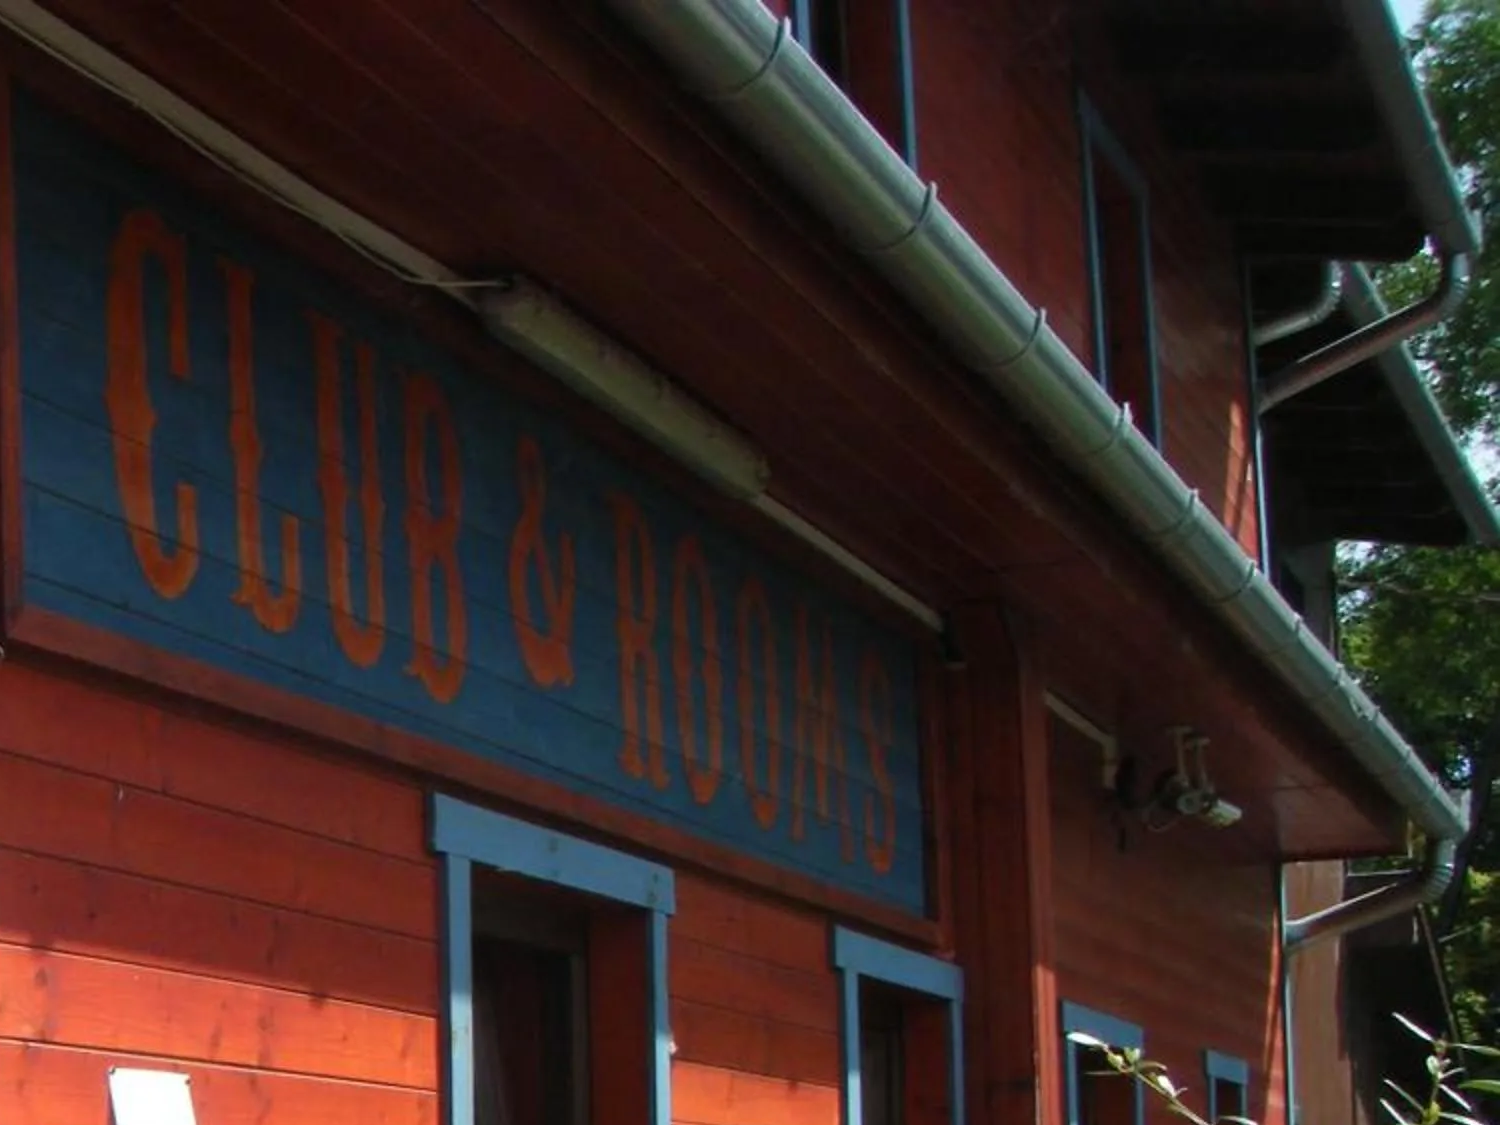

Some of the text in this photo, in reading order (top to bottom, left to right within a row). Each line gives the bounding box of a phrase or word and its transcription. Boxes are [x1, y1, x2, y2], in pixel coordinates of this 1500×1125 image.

[106, 208, 897, 875] CLUB & ROOMS
